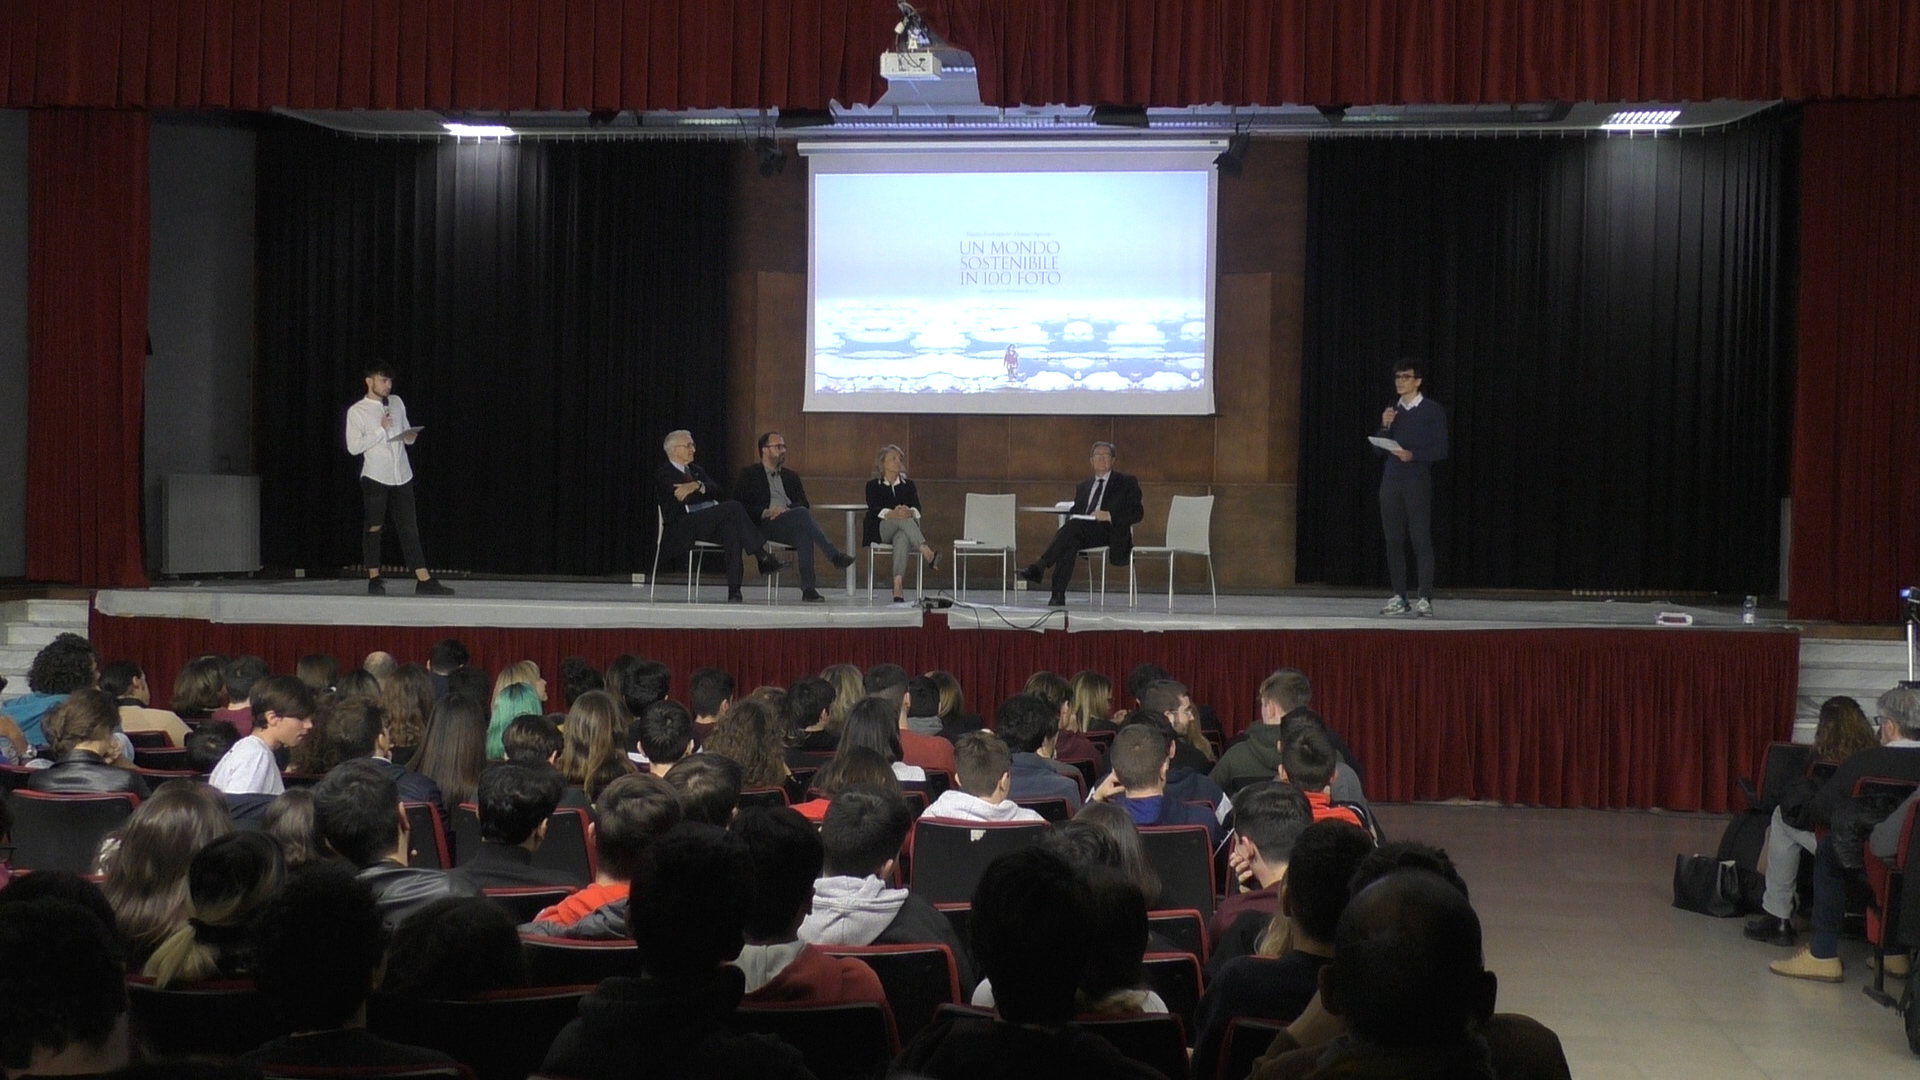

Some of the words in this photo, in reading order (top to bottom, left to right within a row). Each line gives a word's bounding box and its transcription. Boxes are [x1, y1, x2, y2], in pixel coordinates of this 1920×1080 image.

[960, 241, 984, 255] UN
[991, 241, 1060, 255] MONDO
[960, 256, 1059, 270] SOSTENIBILE
[961, 271, 978, 285] IN
[984, 271, 1012, 285] 100
[1018, 271, 1061, 285] FOTO
